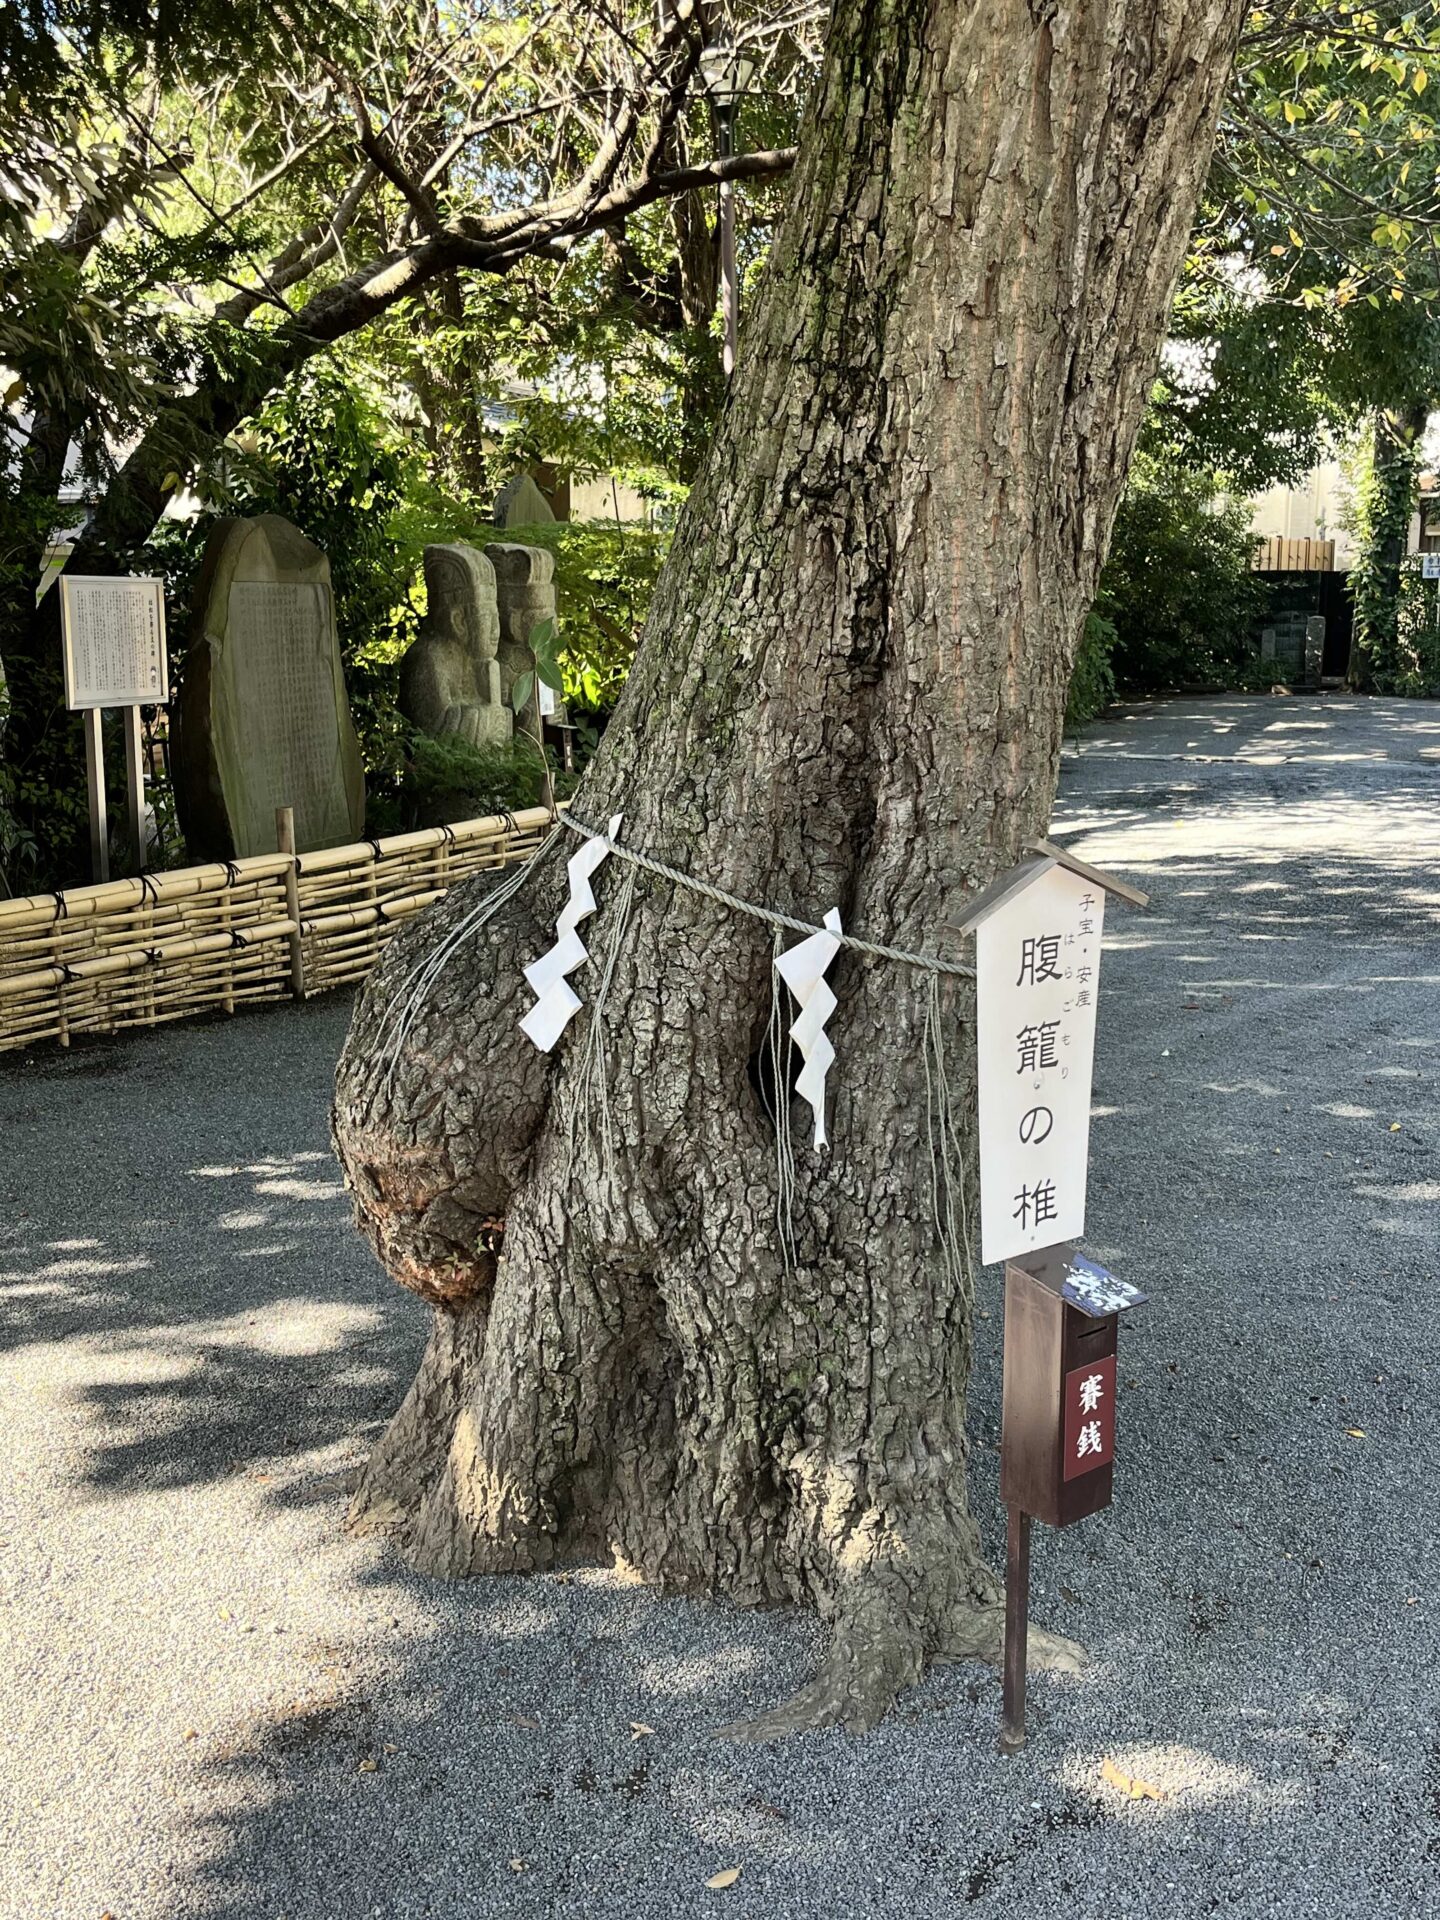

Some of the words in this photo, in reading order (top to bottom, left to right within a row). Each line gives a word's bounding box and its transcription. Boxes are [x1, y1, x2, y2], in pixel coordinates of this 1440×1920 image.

[1061, 933, 1075, 1080] はらごもり
[1076, 893, 1096, 1008] 子宝・安産
[1012, 934, 1063, 1231] 腹籠の椎
[1076, 1374, 1105, 1459] 賽銭
